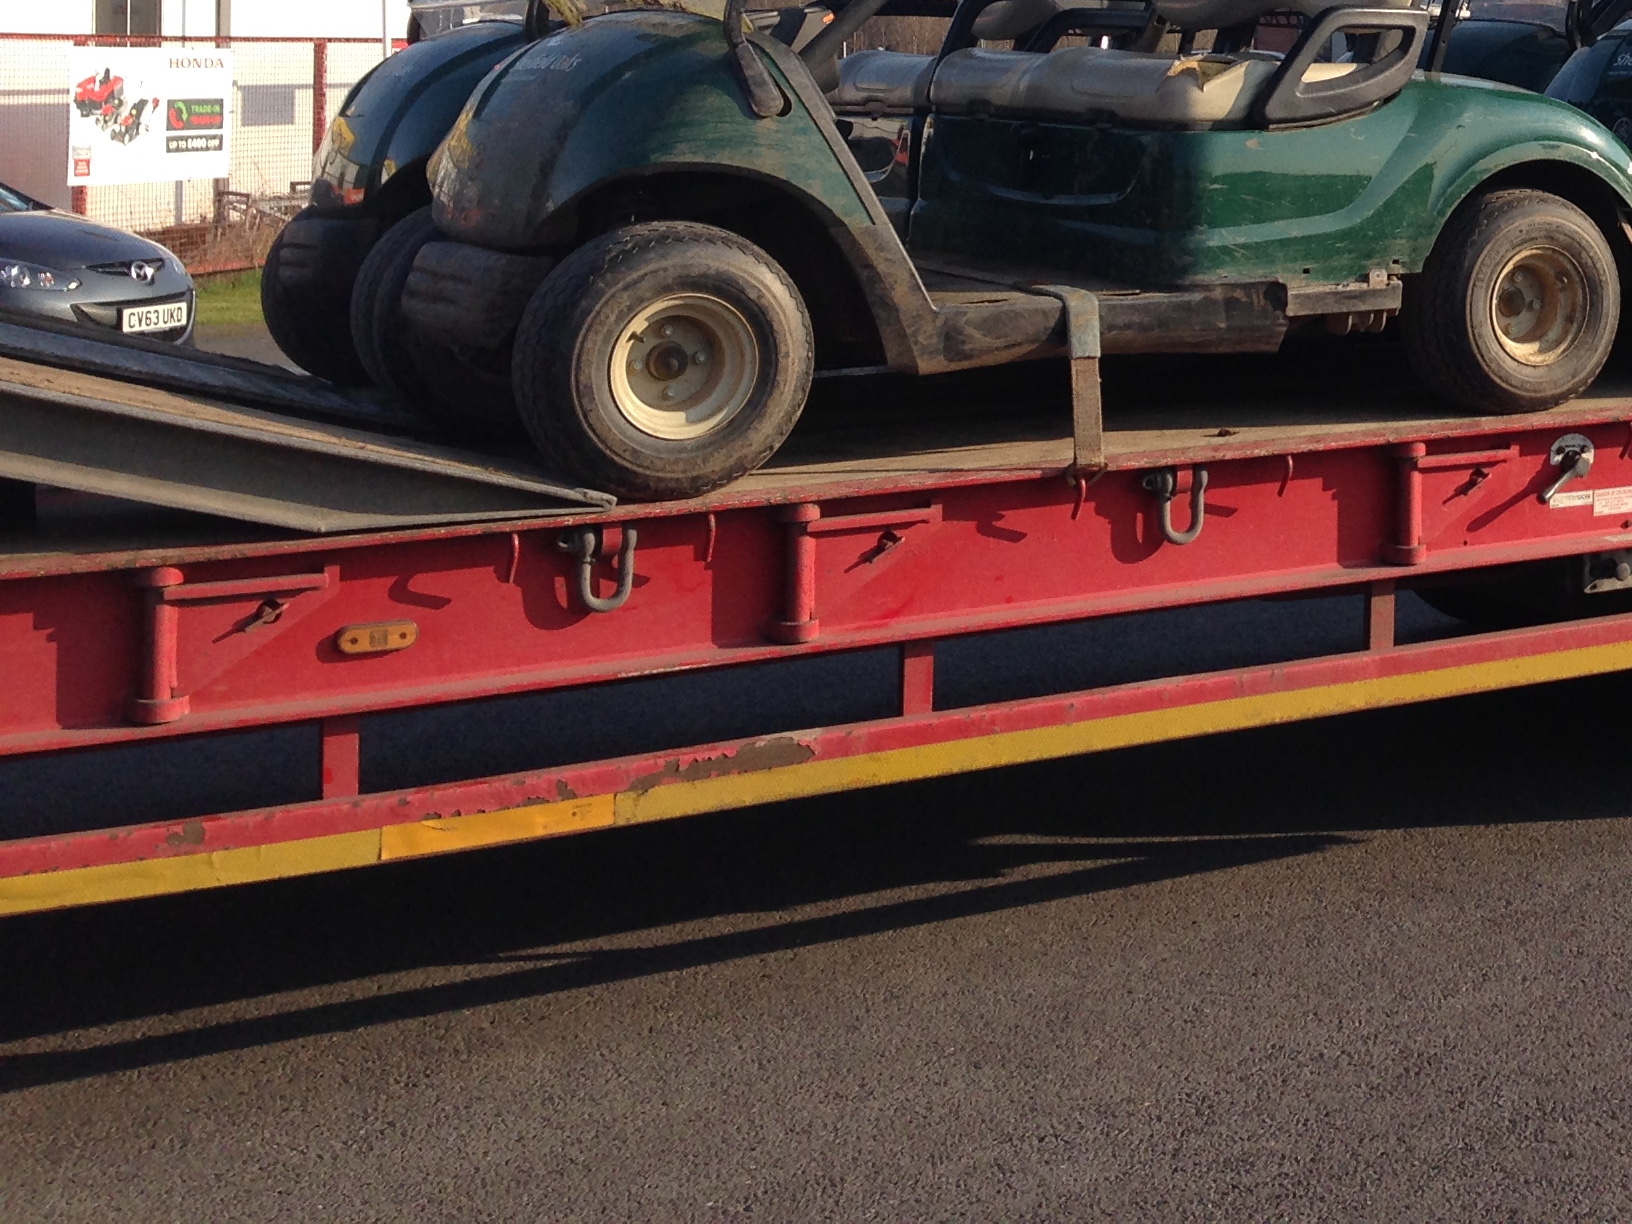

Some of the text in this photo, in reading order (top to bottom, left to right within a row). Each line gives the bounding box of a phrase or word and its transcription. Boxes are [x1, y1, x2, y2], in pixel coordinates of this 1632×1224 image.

[169, 57, 225, 69] HONDA
[128, 306, 183, 329] CV63 UKD
